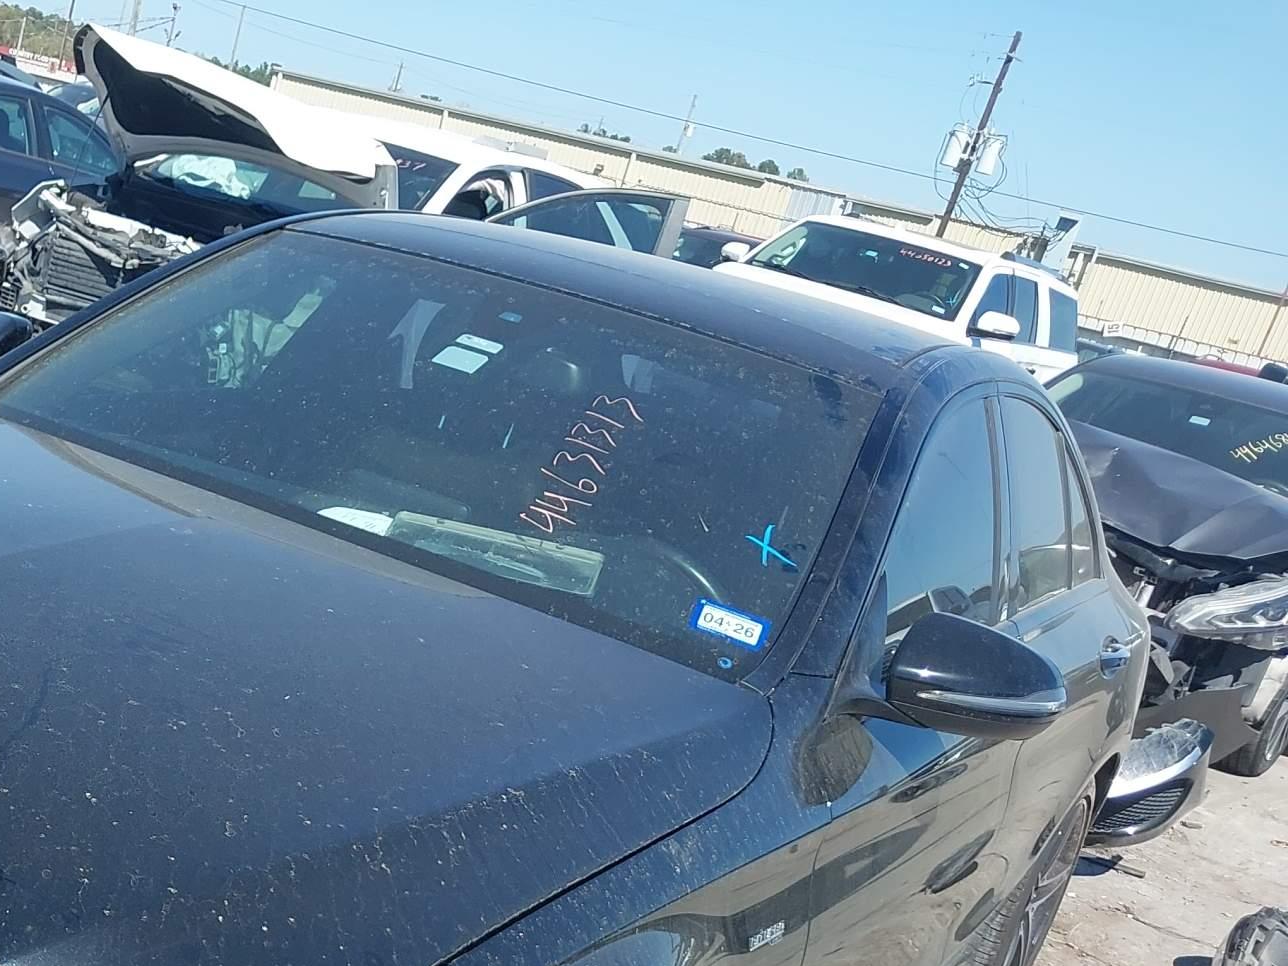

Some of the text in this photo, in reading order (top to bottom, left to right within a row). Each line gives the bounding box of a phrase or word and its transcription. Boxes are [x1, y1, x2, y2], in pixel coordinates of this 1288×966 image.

[519, 394, 644, 533] 44631313
[703, 612, 756, 639] 04 26
